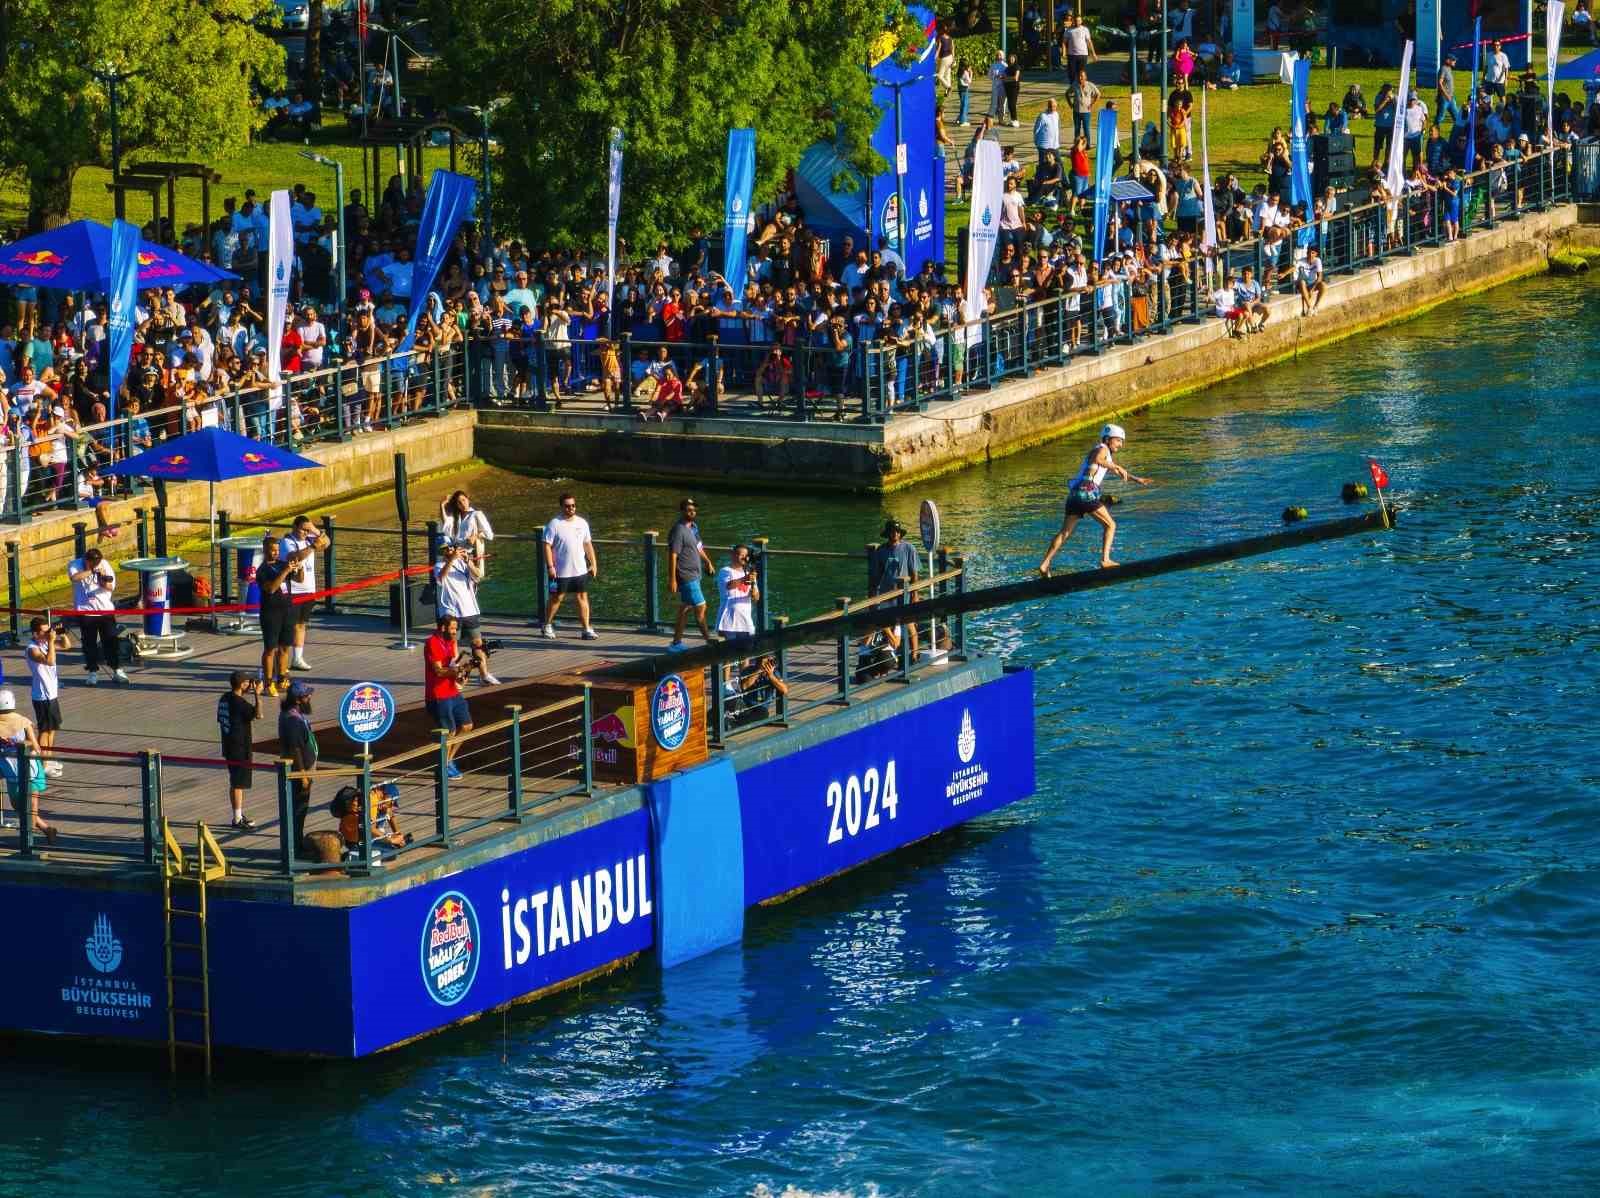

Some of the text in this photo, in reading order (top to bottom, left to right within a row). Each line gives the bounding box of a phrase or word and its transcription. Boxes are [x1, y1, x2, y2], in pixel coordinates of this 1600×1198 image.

[827, 760, 899, 845] 2024
[501, 854, 653, 971] İSTANBUL
[74, 975, 137, 990] İSTANBUL
[62, 985, 152, 1008] BÜYÜKŞEHİR
[76, 1006, 141, 1019] BELEDİYESİ
